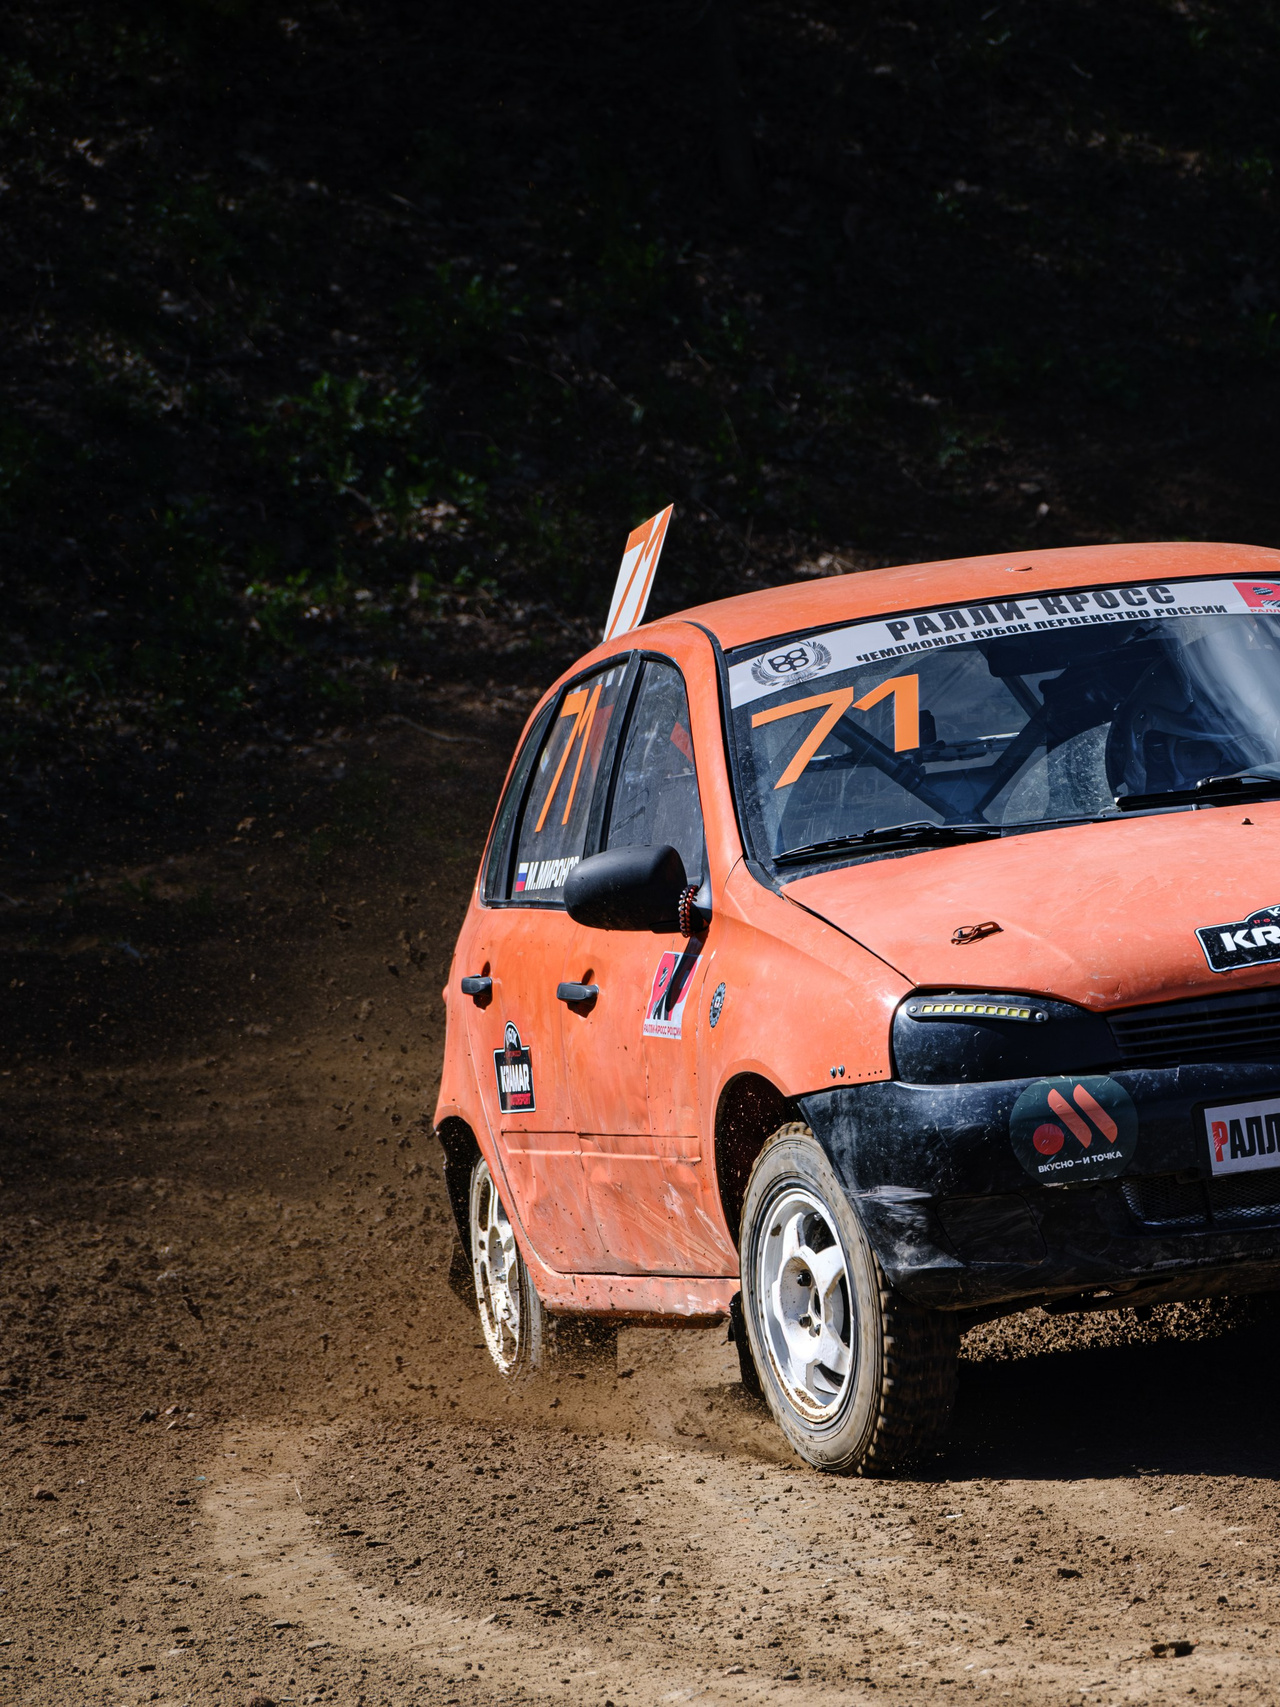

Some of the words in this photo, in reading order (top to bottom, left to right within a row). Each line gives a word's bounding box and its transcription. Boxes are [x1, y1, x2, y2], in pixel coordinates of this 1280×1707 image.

[606, 505, 673, 641] 71
[885, 586, 1176, 641] РАЛЛИ-КРОСС
[856, 632, 968, 664] ЧЕМПИОНАТ
[971, 621, 1032, 640] КУБОК
[1034, 608, 1151, 630] ПЕРВЕНСТВО
[1152, 604, 1229, 623] РОССИИ
[535, 683, 603, 833] 71
[751, 673, 920, 790] 71
[1037, 1159, 1074, 1173] ВКУСНО
[1091, 1150, 1123, 1163] ТОЧКА
